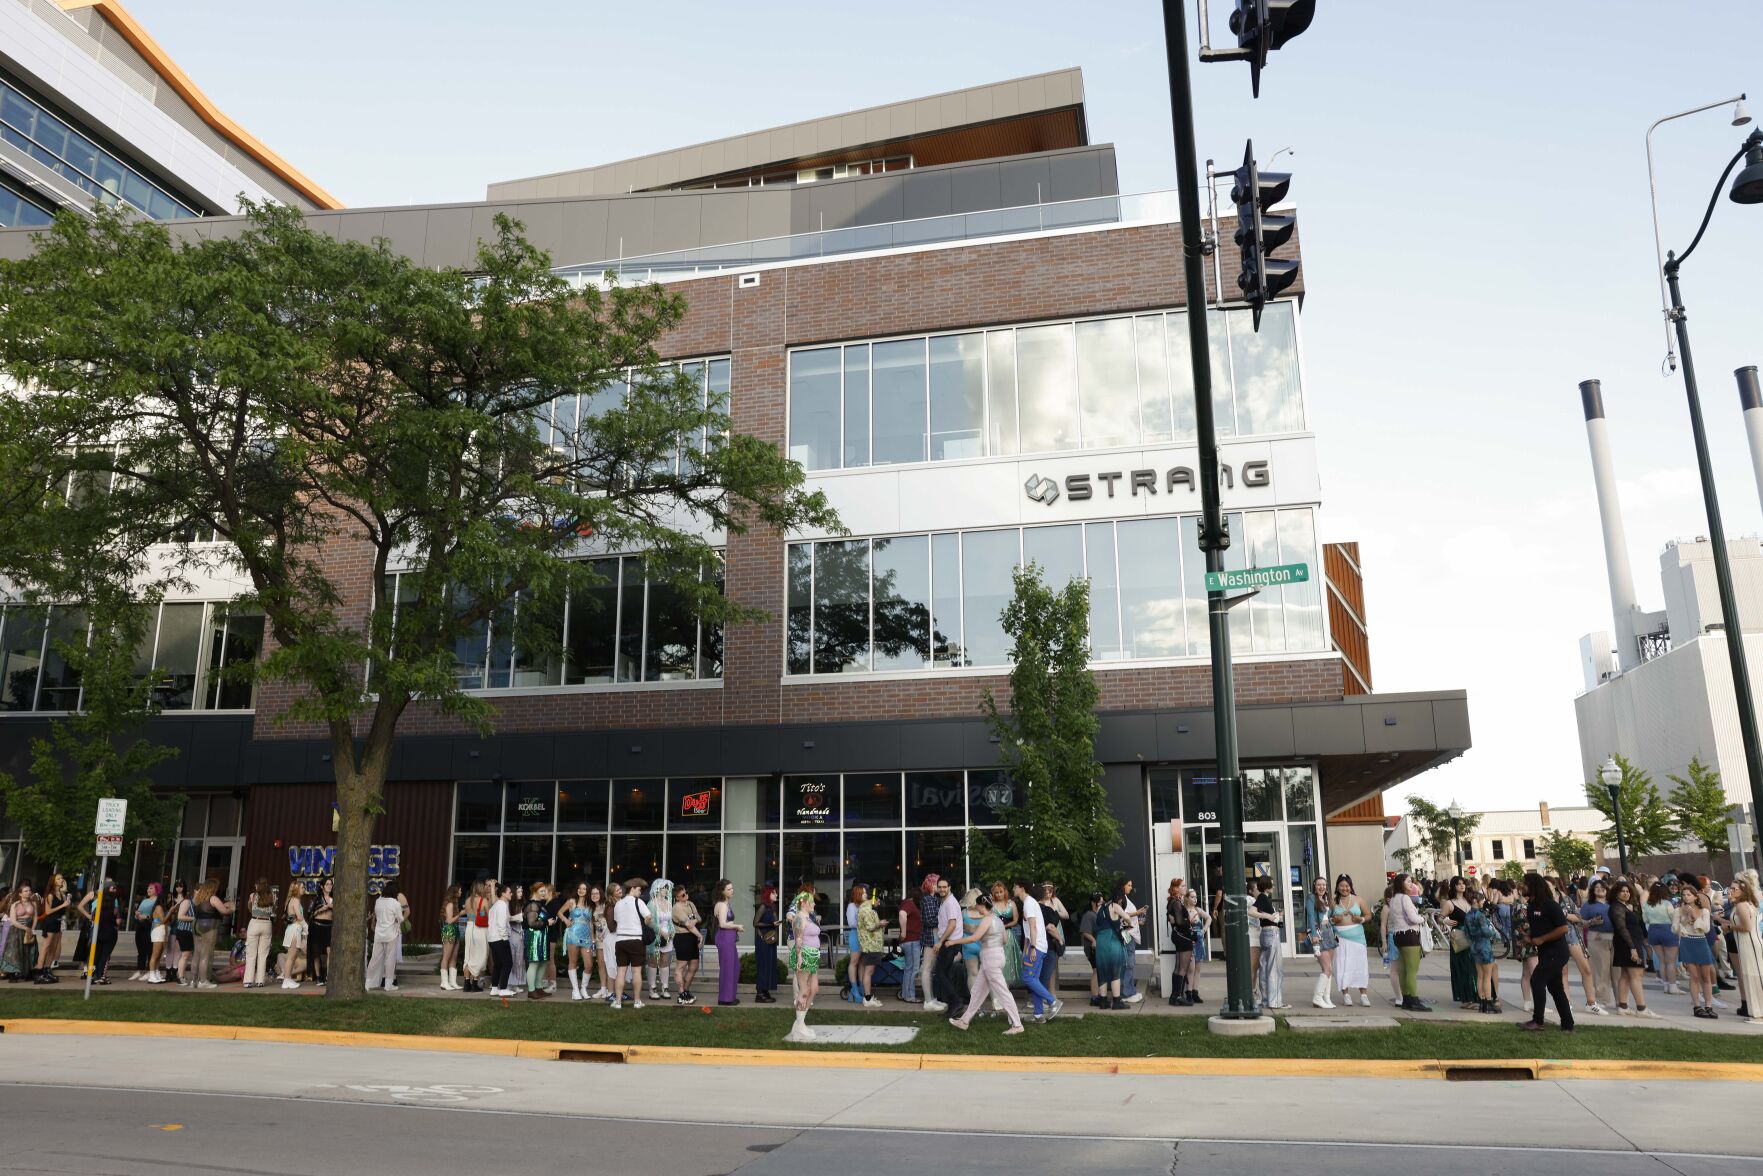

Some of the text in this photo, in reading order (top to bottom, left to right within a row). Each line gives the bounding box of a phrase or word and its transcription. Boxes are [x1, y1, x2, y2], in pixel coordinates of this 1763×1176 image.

[1209, 568, 1304, 587] E Washington Av
[800, 782, 826, 792] Tito's
[518, 803, 546, 811] KORBEL
[1198, 812, 1216, 820] 803
[289, 845, 400, 877] VINGE
